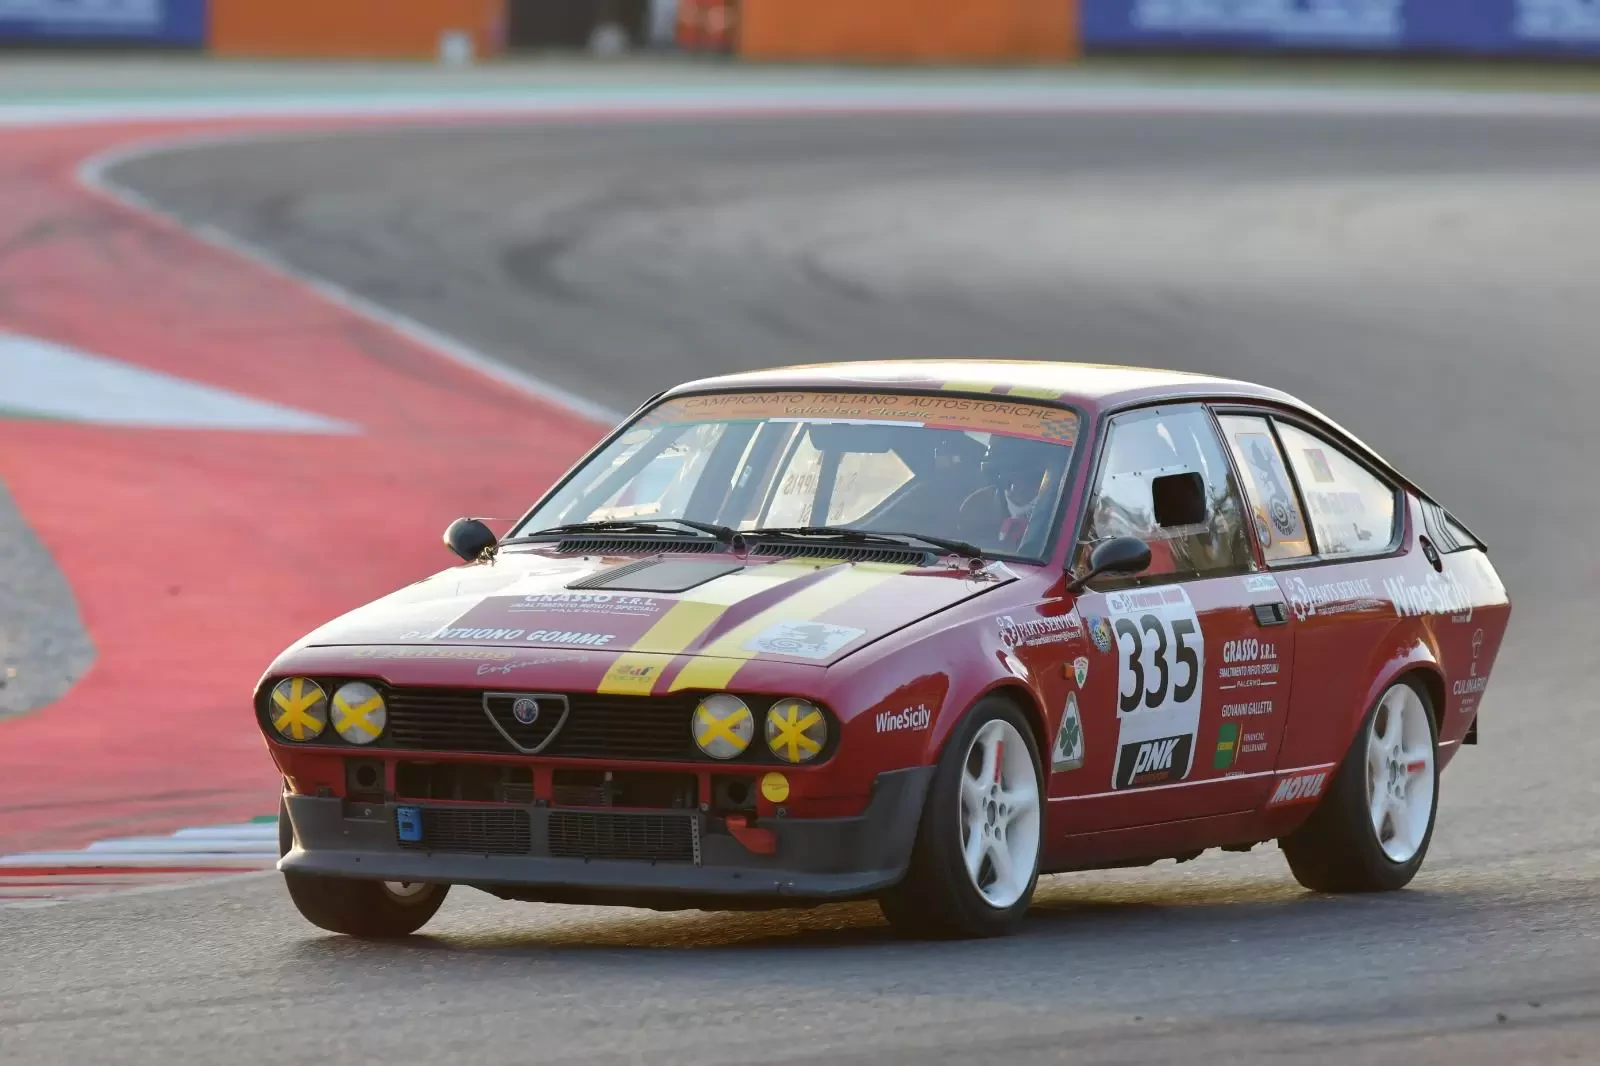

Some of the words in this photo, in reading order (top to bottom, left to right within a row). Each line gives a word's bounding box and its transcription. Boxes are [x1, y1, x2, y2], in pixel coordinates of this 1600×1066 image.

[685, 393, 804, 409] CAMPIONATO
[812, 394, 898, 406] ITALIANO
[909, 397, 1057, 420] AUTOSTORICHE
[1311, 581, 1337, 602] PARTS
[1337, 577, 1375, 599] SERVICE
[1383, 570, 1474, 623] WineSicily
[526, 630, 617, 646] GOMME
[1018, 620, 1045, 638] PARTS
[1045, 612, 1080, 632] SERVICE
[1114, 614, 1199, 713] 335
[1223, 638, 1258, 663] GRASSO
[1260, 643, 1277, 660] S.R.L.
[876, 703, 931, 733] WineSicily
[1221, 703, 1248, 718] GIOVANNI
[1248, 700, 1272, 716] GALLETTA
[1270, 772, 1326, 804] MOTUL
